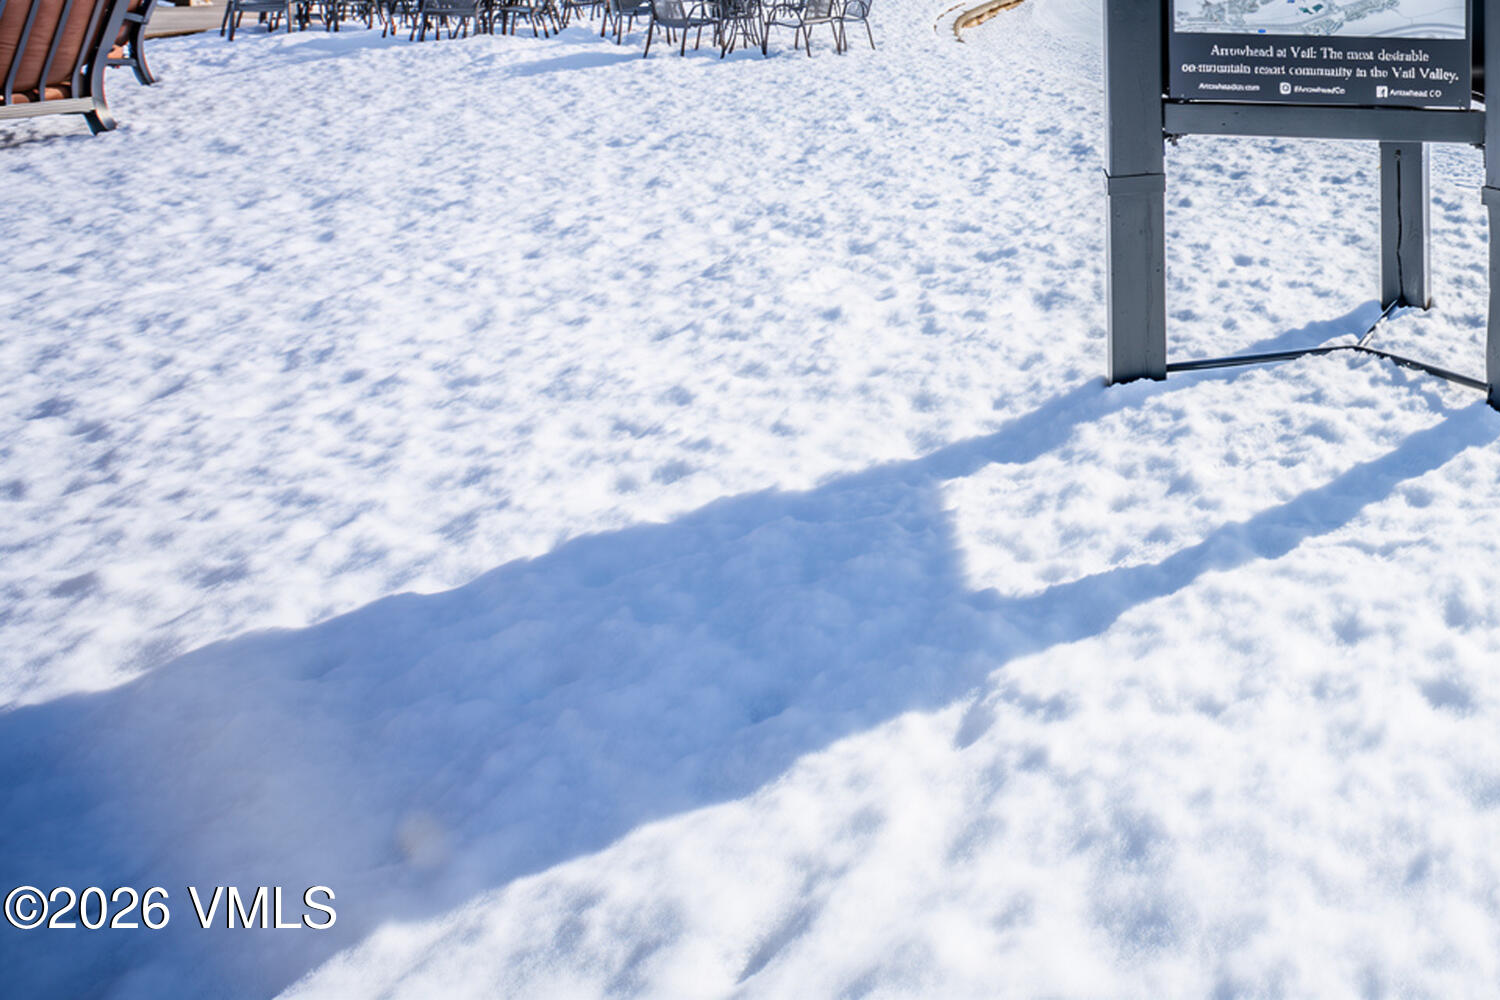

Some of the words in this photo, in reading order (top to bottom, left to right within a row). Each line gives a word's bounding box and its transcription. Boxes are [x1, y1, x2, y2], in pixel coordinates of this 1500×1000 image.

[1210, 44, 1274, 58] Arrowhead
[1276, 47, 1286, 58] at
[1290, 45, 1317, 59] Vail:
[1320, 46, 1343, 60] The
[1346, 49, 1374, 61] most
[1377, 48, 1430, 62] desirable
[1288, 65, 1353, 81] community
[1356, 67, 1367, 78] in
[1370, 65, 1388, 78] the
[1392, 66, 1415, 80] Vail
[1419, 67, 1460, 84] Valley.
